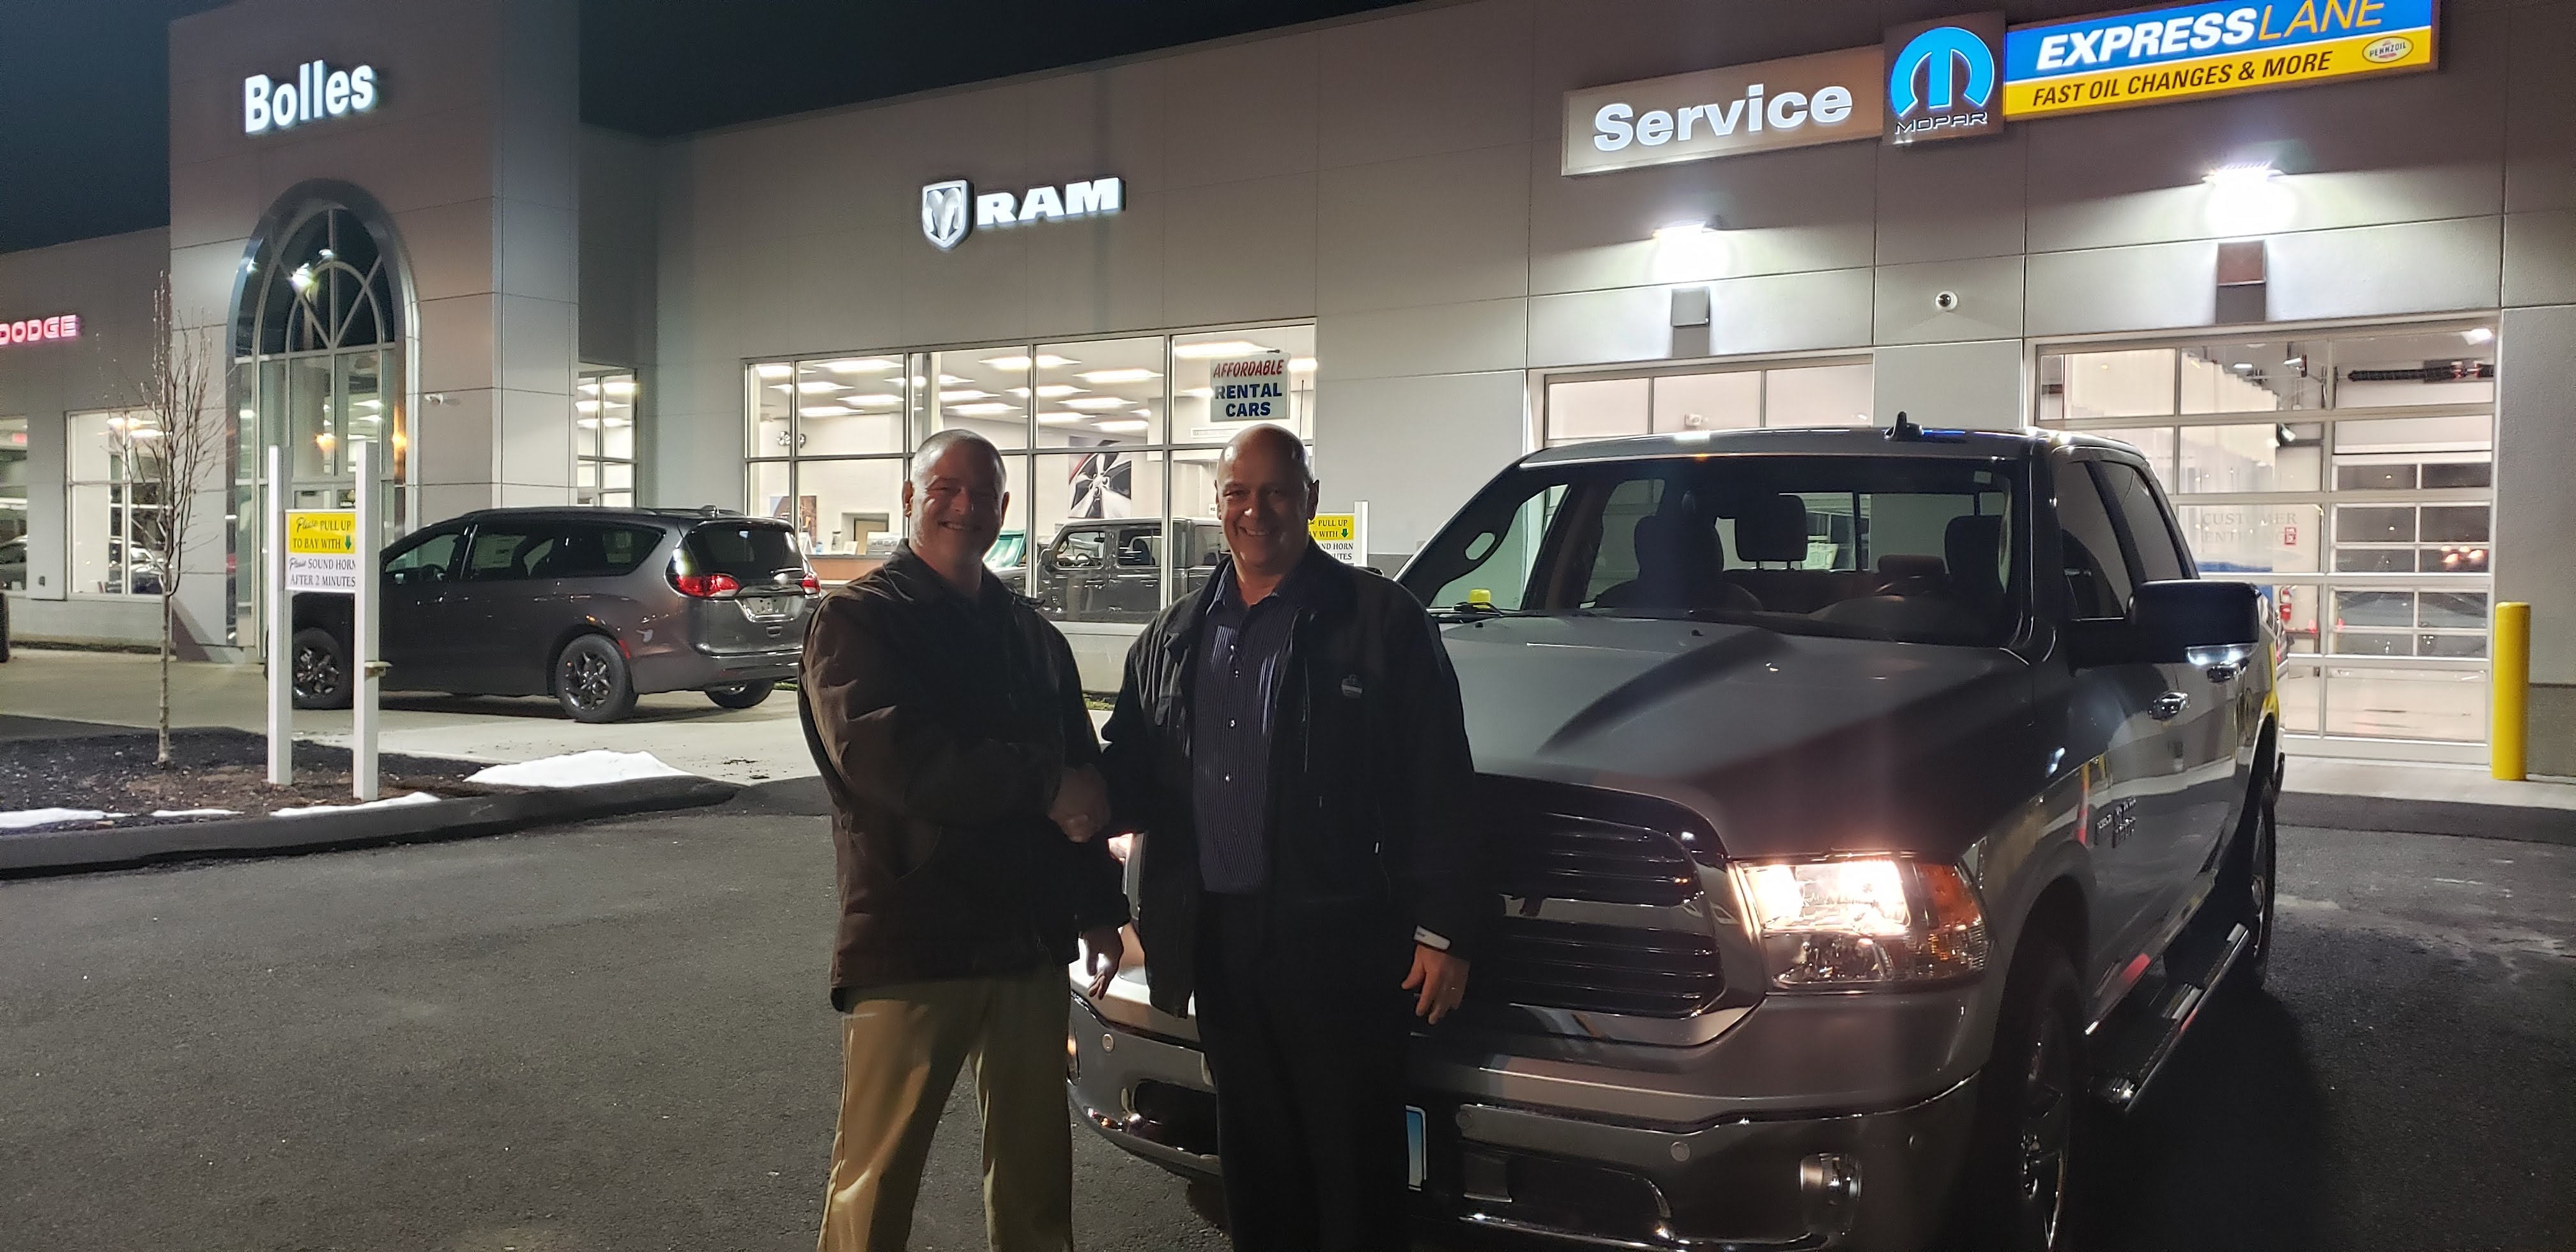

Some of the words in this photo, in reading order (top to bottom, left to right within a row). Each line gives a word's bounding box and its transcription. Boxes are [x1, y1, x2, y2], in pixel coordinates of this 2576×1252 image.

[2369, 42, 2407, 57] PENNZOIL
[2033, 83, 2085, 106] FAST
[2089, 79, 2120, 99] OIL
[2128, 64, 2232, 95] CHANGES
[2238, 61, 2255, 80] &
[2262, 50, 2333, 77] MORE
[245, 59, 374, 133] Bolles
[1593, 83, 1853, 151] Service
[1894, 112, 1988, 135] MOPAR
[977, 178, 1120, 225] RAM
[0, 314, 77, 345] DODGE
[1213, 359, 1284, 378] AFFORDABLE
[1215, 383, 1282, 399] RENTAL
[1226, 402, 1271, 417] CARS
[320, 521, 339, 531] PULL
[341, 521, 351, 531] UP
[293, 538, 302, 548] TO
[305, 538, 319, 549] BAY
[321, 538, 341, 549] WITH
[308, 558, 334, 569] SOUND
[291, 575, 313, 585] AFTER
[316, 576, 319, 585] 2
[323, 576, 355, 587] MINUTES
